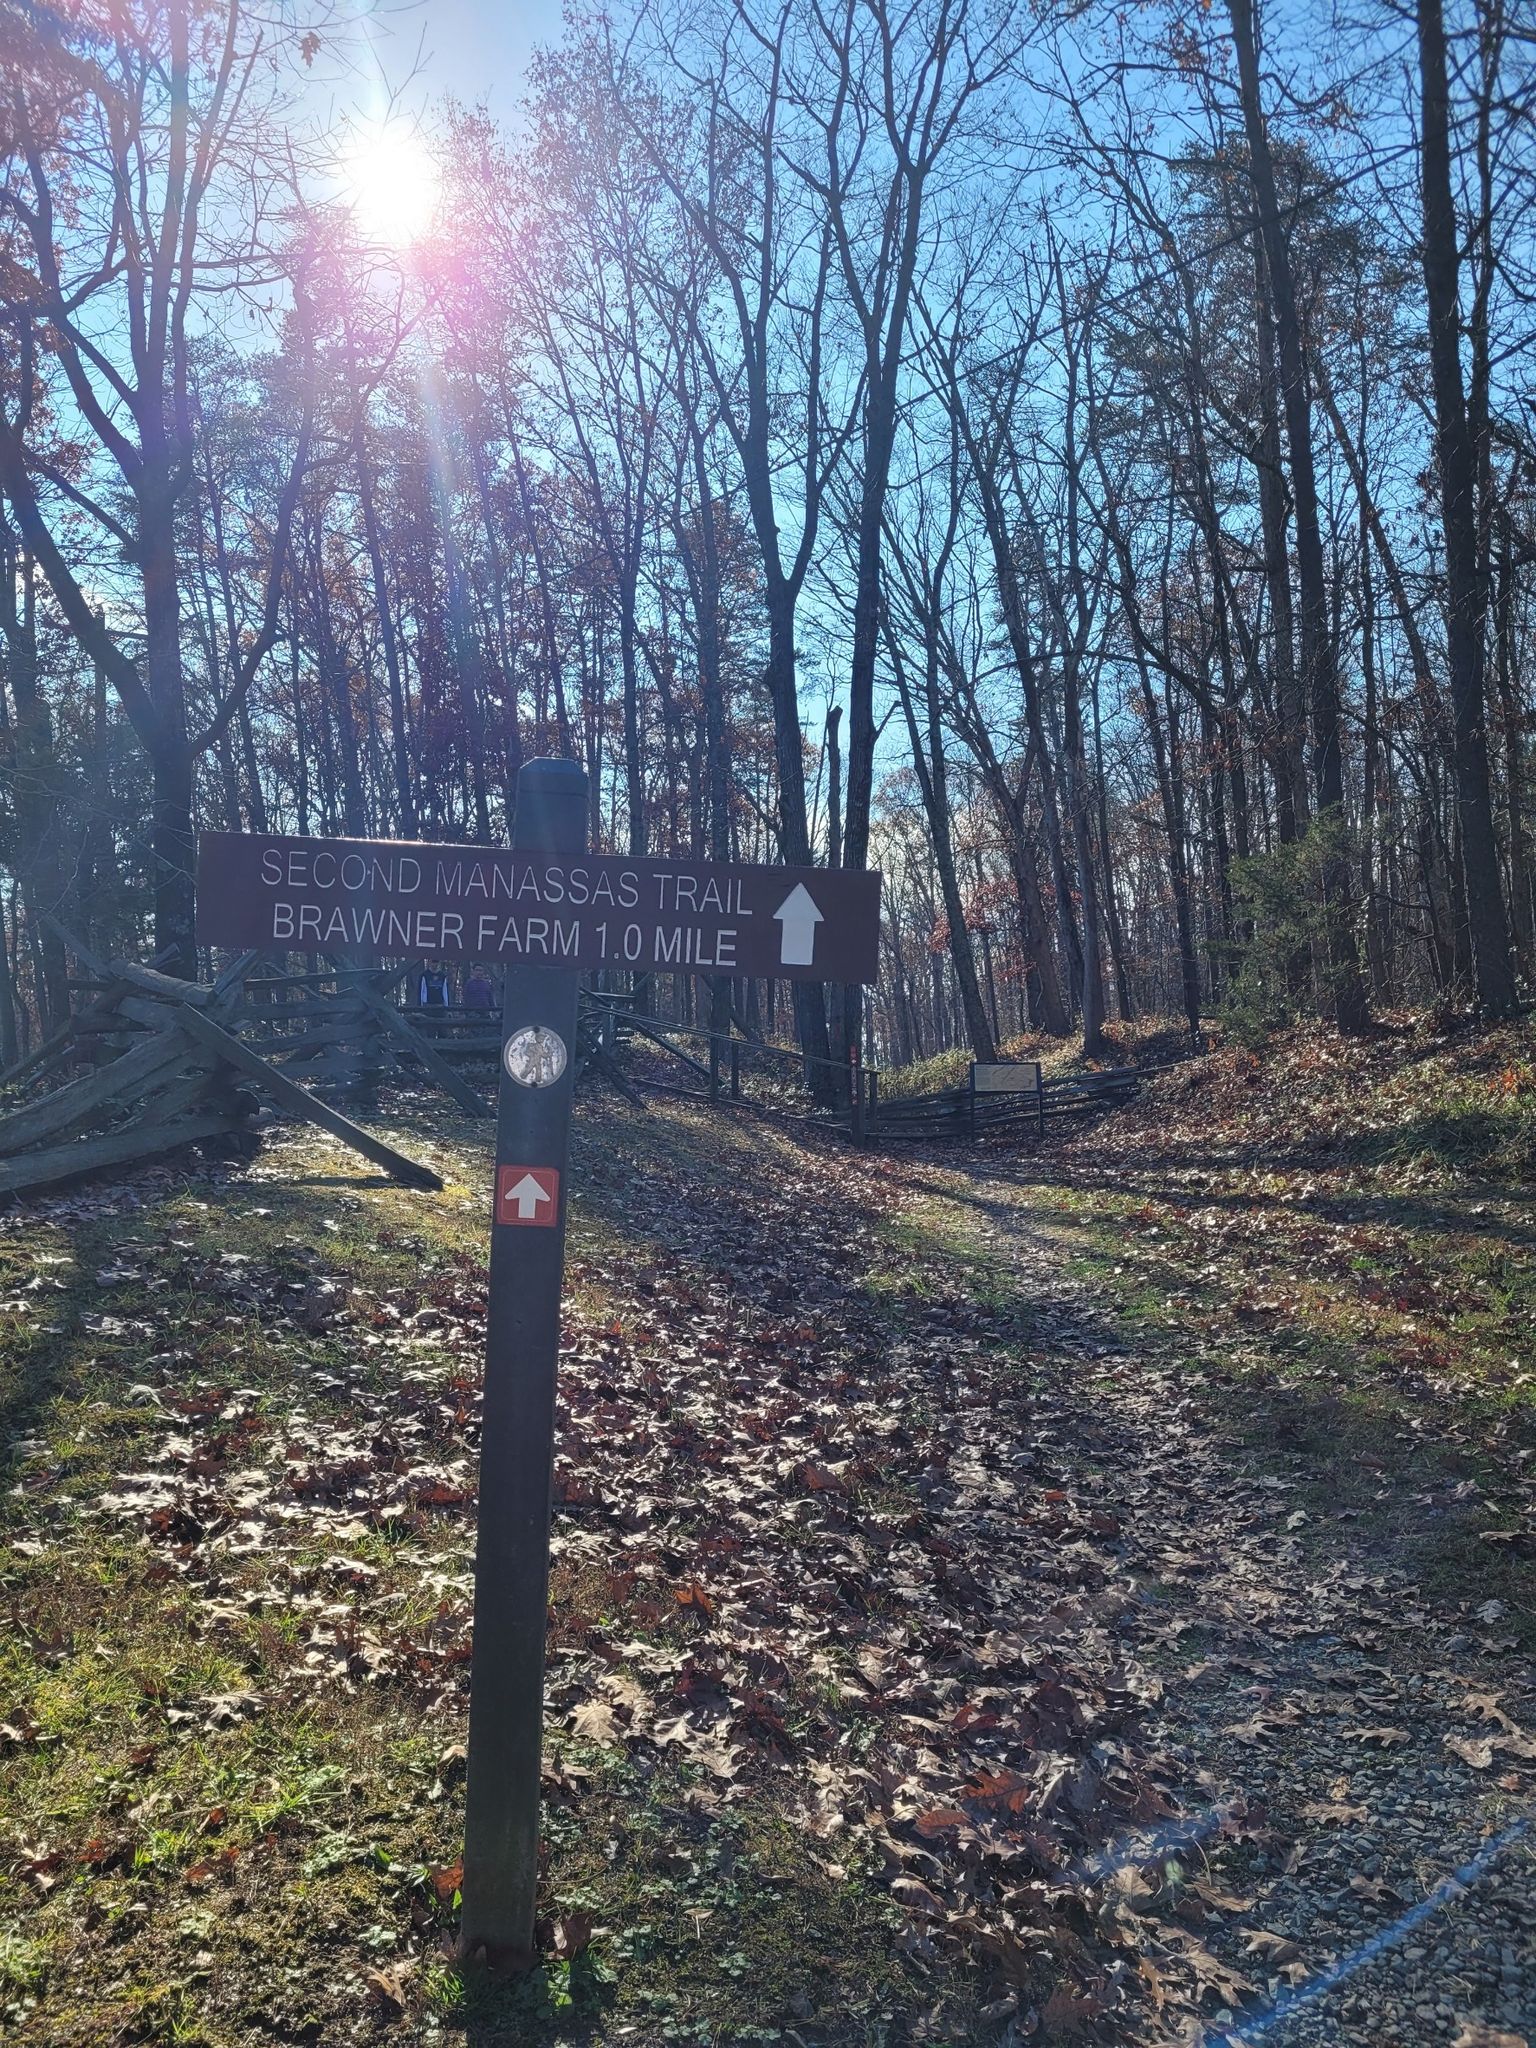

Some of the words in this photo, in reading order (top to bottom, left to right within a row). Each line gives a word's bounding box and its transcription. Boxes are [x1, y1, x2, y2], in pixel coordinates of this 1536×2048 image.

[261, 848, 421, 893] SECOND
[436, 861, 639, 908] MANASSAS
[652, 872, 753, 916] TRAIL
[273, 902, 463, 949] BRAWNER
[476, 914, 581, 959] FARM
[595, 922, 643, 962] 1.0
[653, 926, 737, 967] MILE
